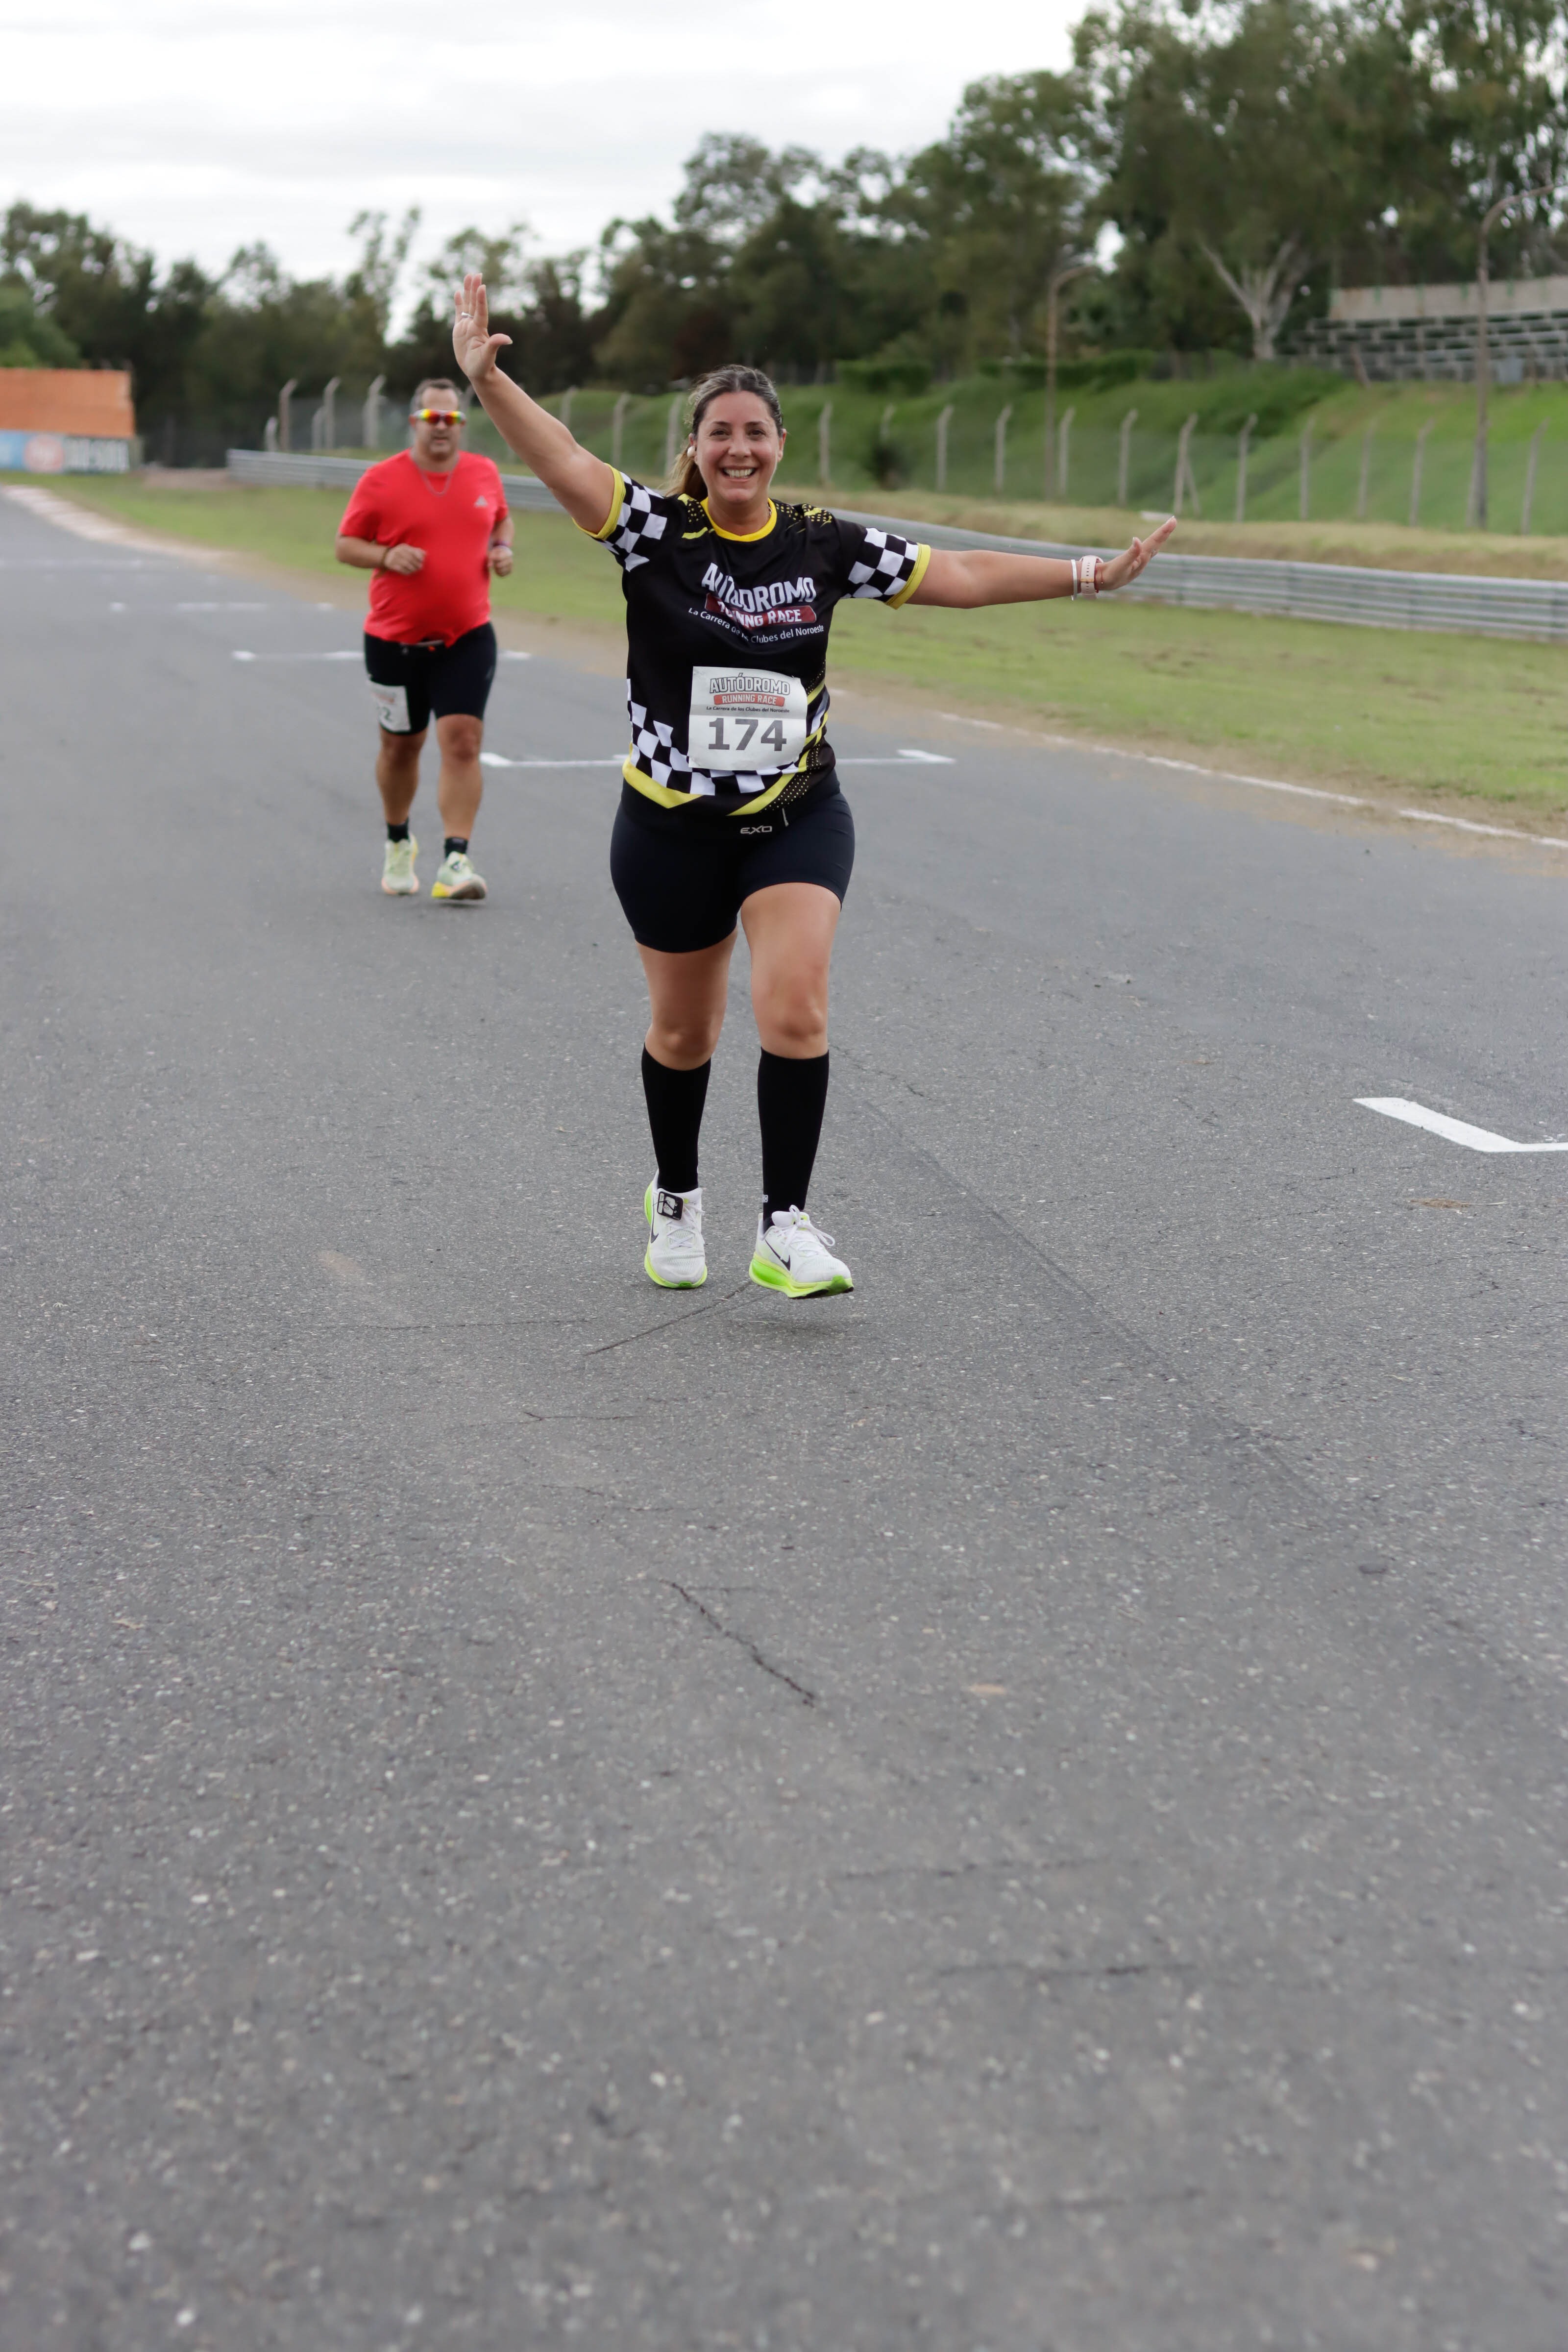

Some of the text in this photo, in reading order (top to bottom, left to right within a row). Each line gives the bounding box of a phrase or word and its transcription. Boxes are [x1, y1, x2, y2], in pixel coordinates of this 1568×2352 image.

[767, 609, 802, 624] RACE
[700, 611, 730, 629] Carrera
[750, 634, 778, 643] Clubes
[780, 629, 794, 639] del
[795, 624, 824, 637] Noroeste
[710, 673, 790, 695] AUTÓDROMO
[722, 693, 777, 705] RUNNING RACE
[708, 717, 787, 752] 174
[740, 825, 772, 834] EXO
